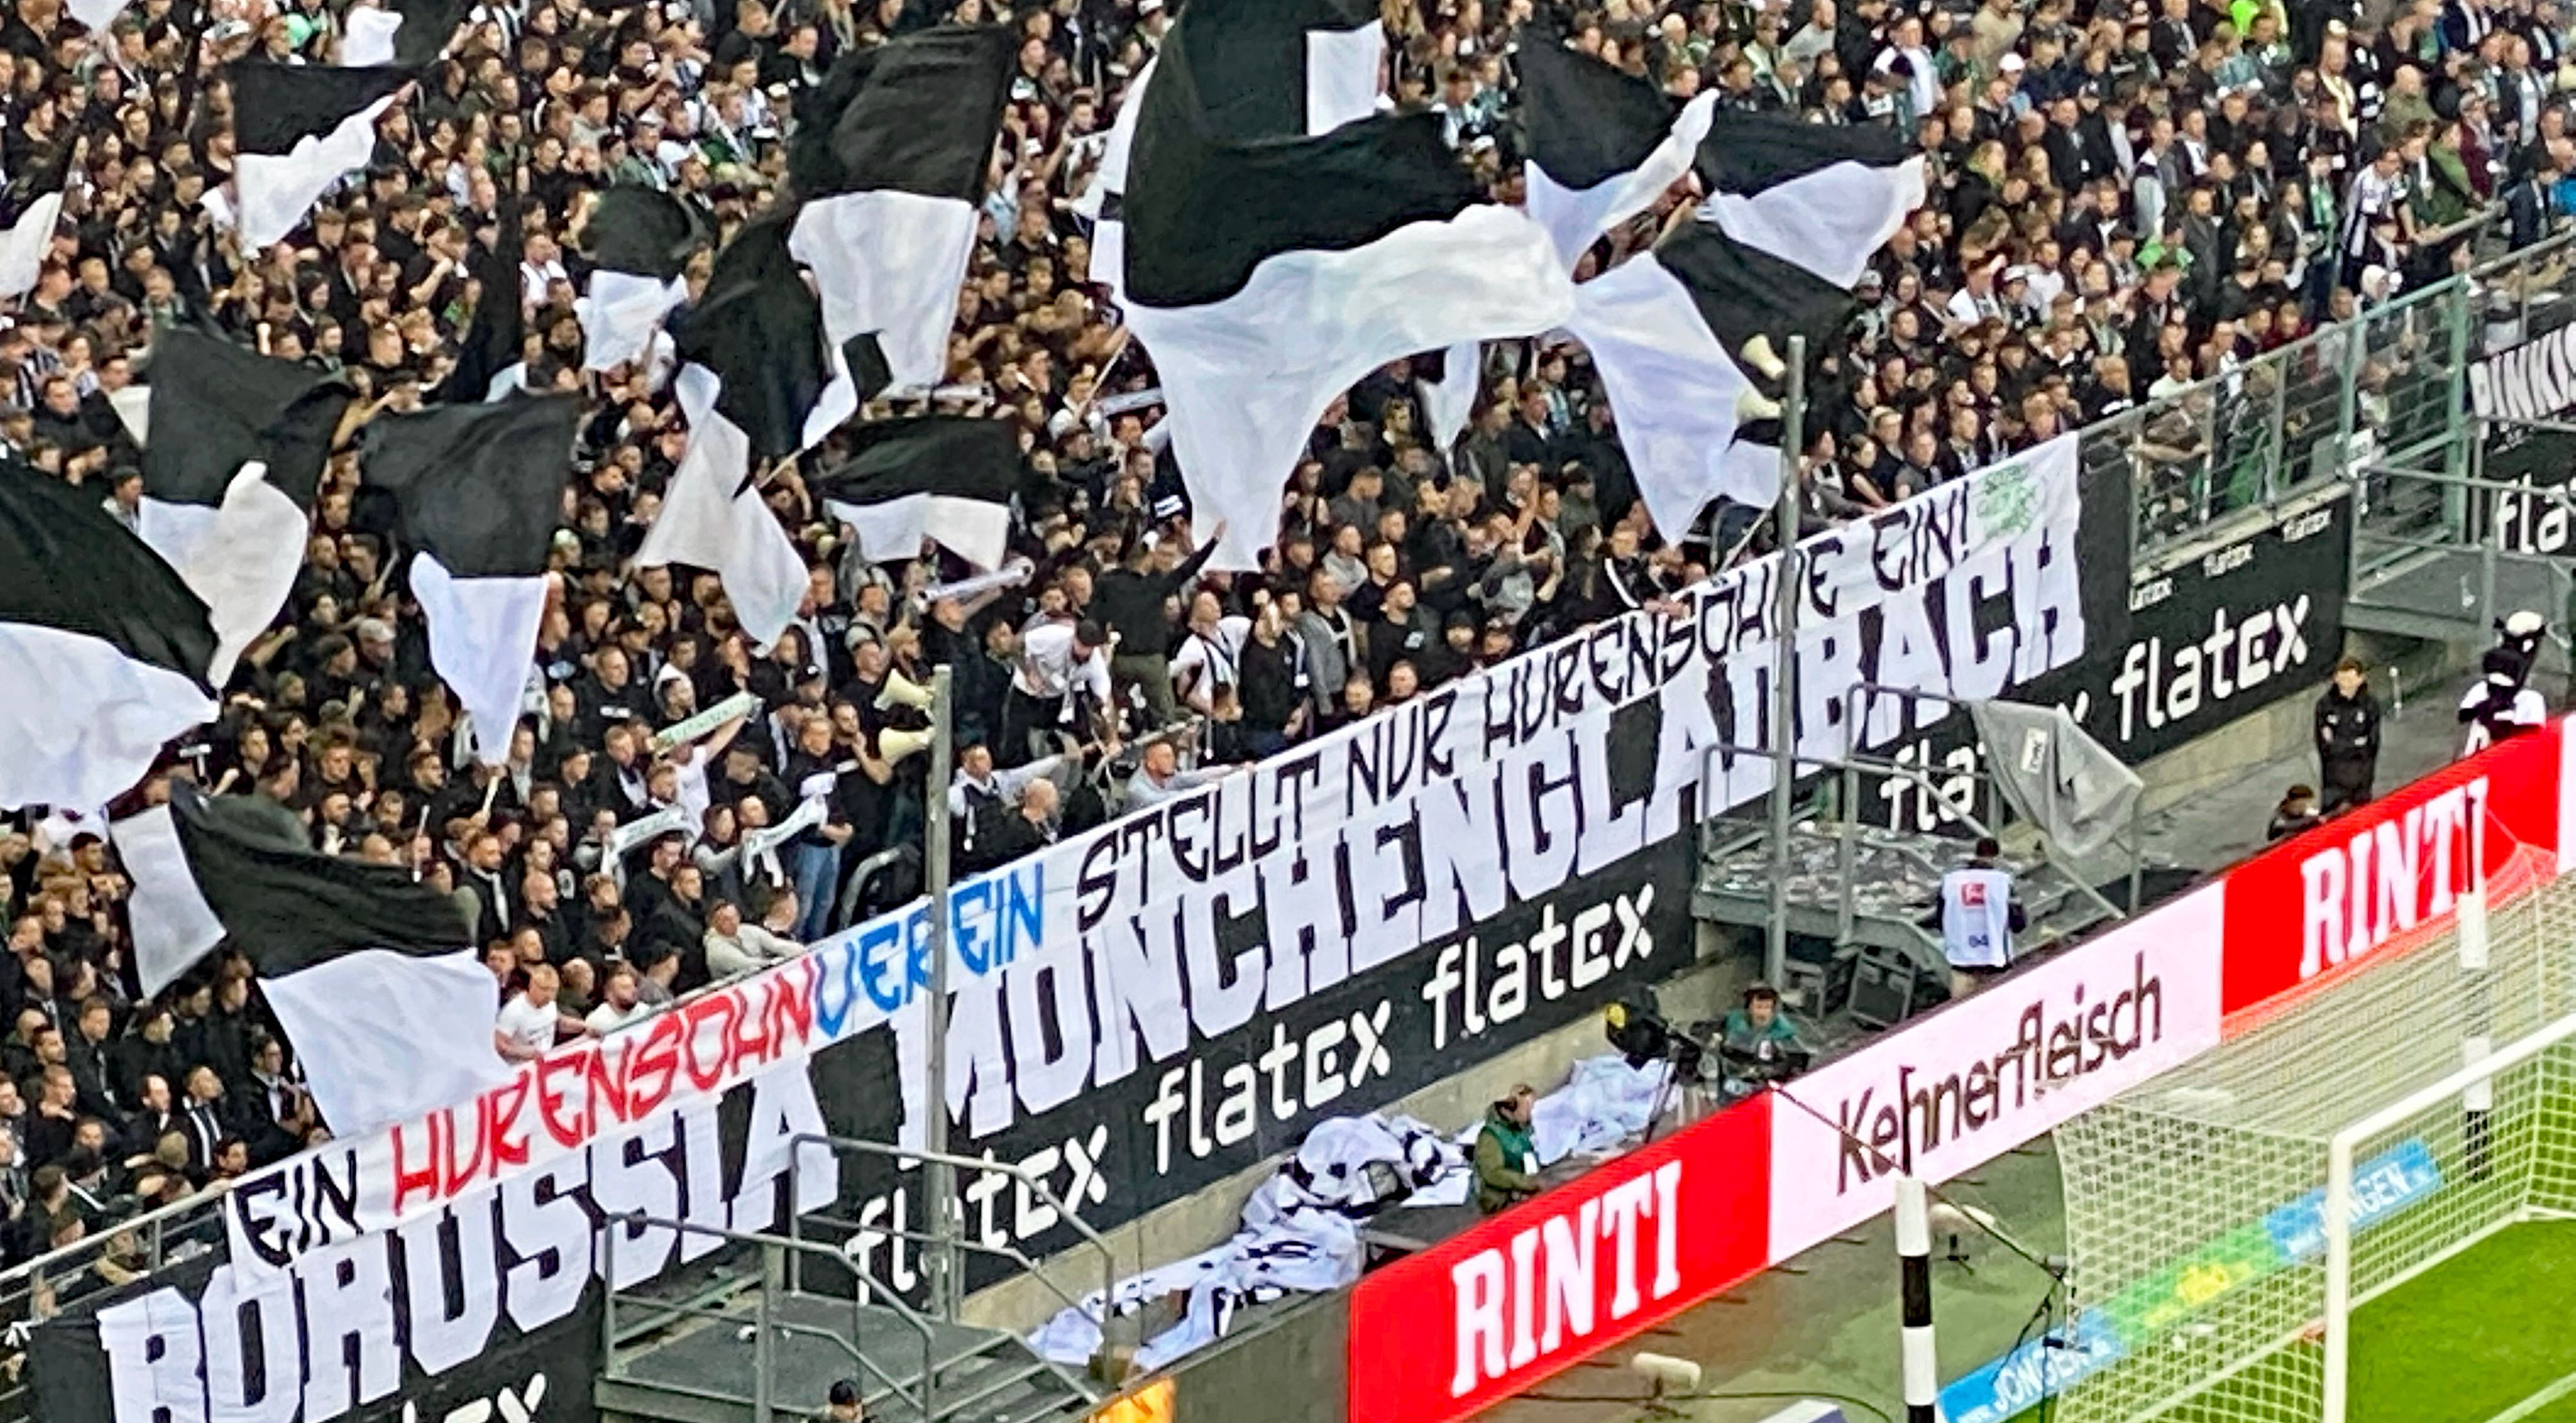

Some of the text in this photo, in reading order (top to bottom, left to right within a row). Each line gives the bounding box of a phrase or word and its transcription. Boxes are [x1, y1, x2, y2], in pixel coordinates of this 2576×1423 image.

[2496, 472, 2576, 555] fla
[236, 1149, 363, 1268] EIN
[1077, 755, 1320, 933] STELLT
[1347, 689, 1457, 817] NUR
[1870, 479, 1969, 591] EIN!
[844, 1123, 1108, 1306] fltex
[1145, 999, 1391, 1174] flatex
[1423, 883, 1654, 1050] flatex
[2112, 594, 2309, 742] flatex
[1452, 1161, 1681, 1398] RINTI
[2298, 776, 2489, 982] RINTI
[97, 1054, 837, 1423] BORUSSIA
